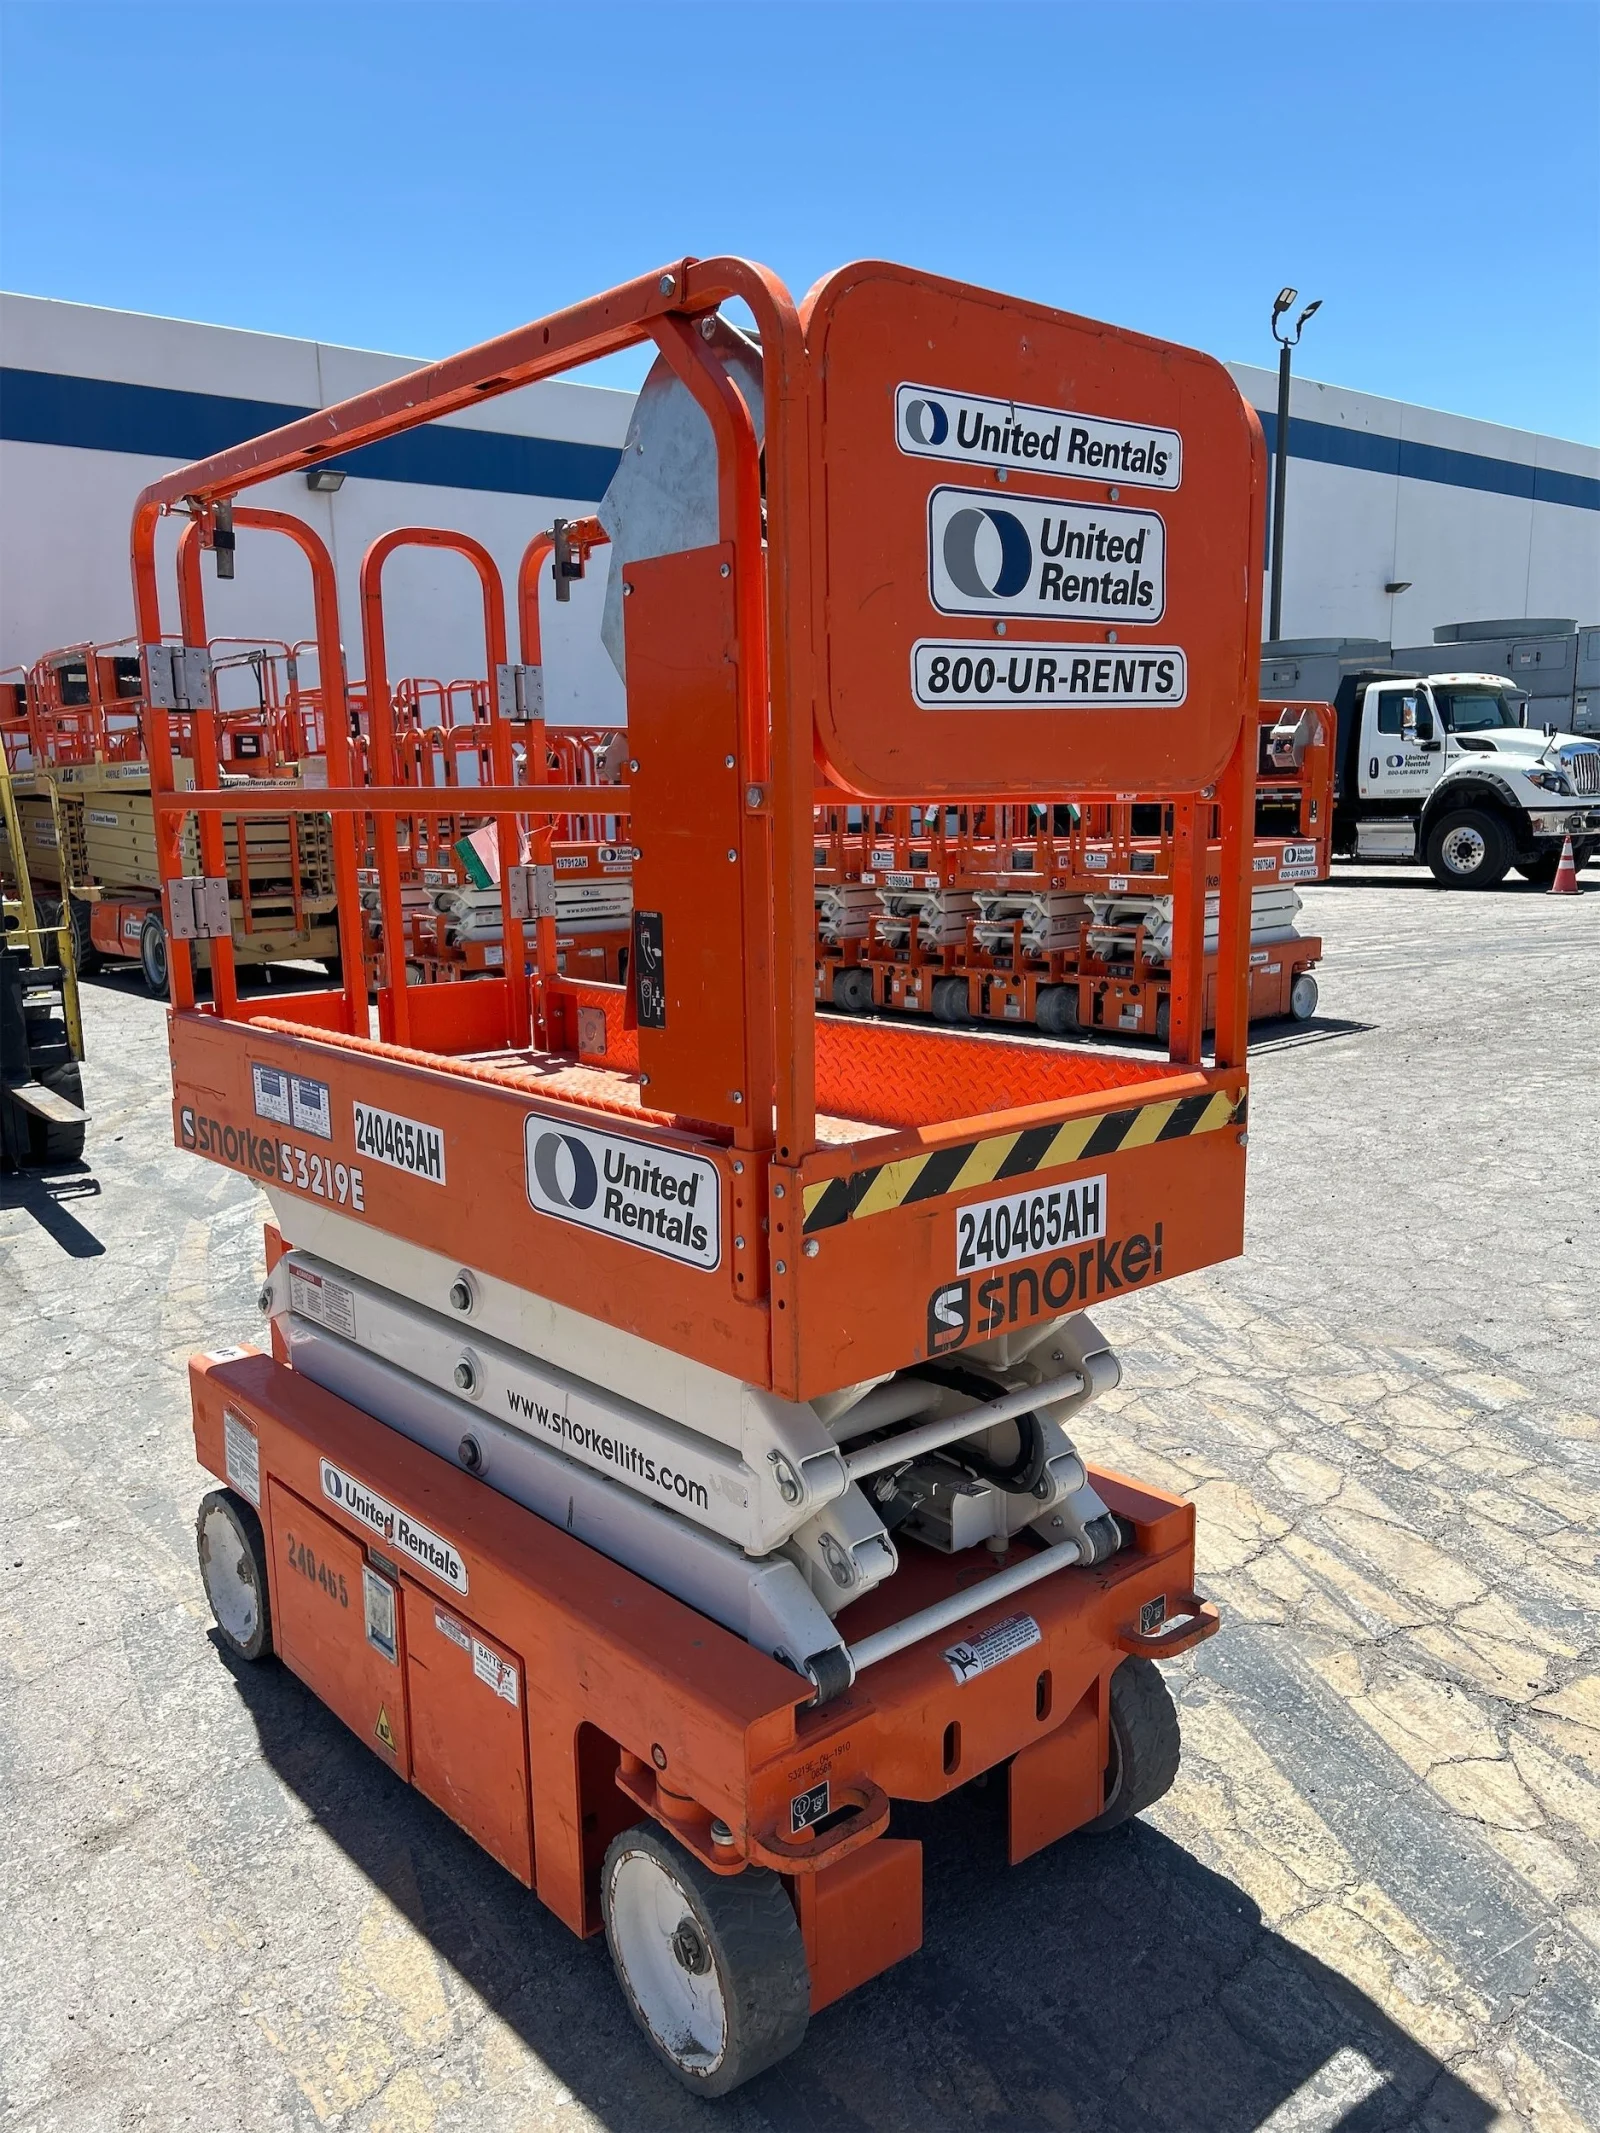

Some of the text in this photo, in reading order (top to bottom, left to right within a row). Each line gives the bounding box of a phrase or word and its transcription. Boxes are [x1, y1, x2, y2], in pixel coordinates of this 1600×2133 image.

[956, 408, 1168, 477] United Rentals
[1039, 517, 1146, 564] United
[1038, 562, 1154, 607] Rentals
[927, 655, 1175, 694] 800-UR-RENTS
[197, 1115, 283, 1180] snorkel
[281, 1142, 366, 1213] S3219E
[355, 1107, 441, 1179] 240465AH
[603, 1148, 699, 1208] United
[603, 1186, 708, 1251] Rentals
[958, 1183, 1100, 1270] 240465AH
[977, 1222, 1163, 1333] snorkel
[507, 1389, 709, 1510] www.snorkellifts.com
[345, 1482, 395, 1539] United
[398, 1517, 459, 1581] Rentals
[286, 1531, 349, 1608] 240465
[984, 1616, 1017, 1635] DANGER
